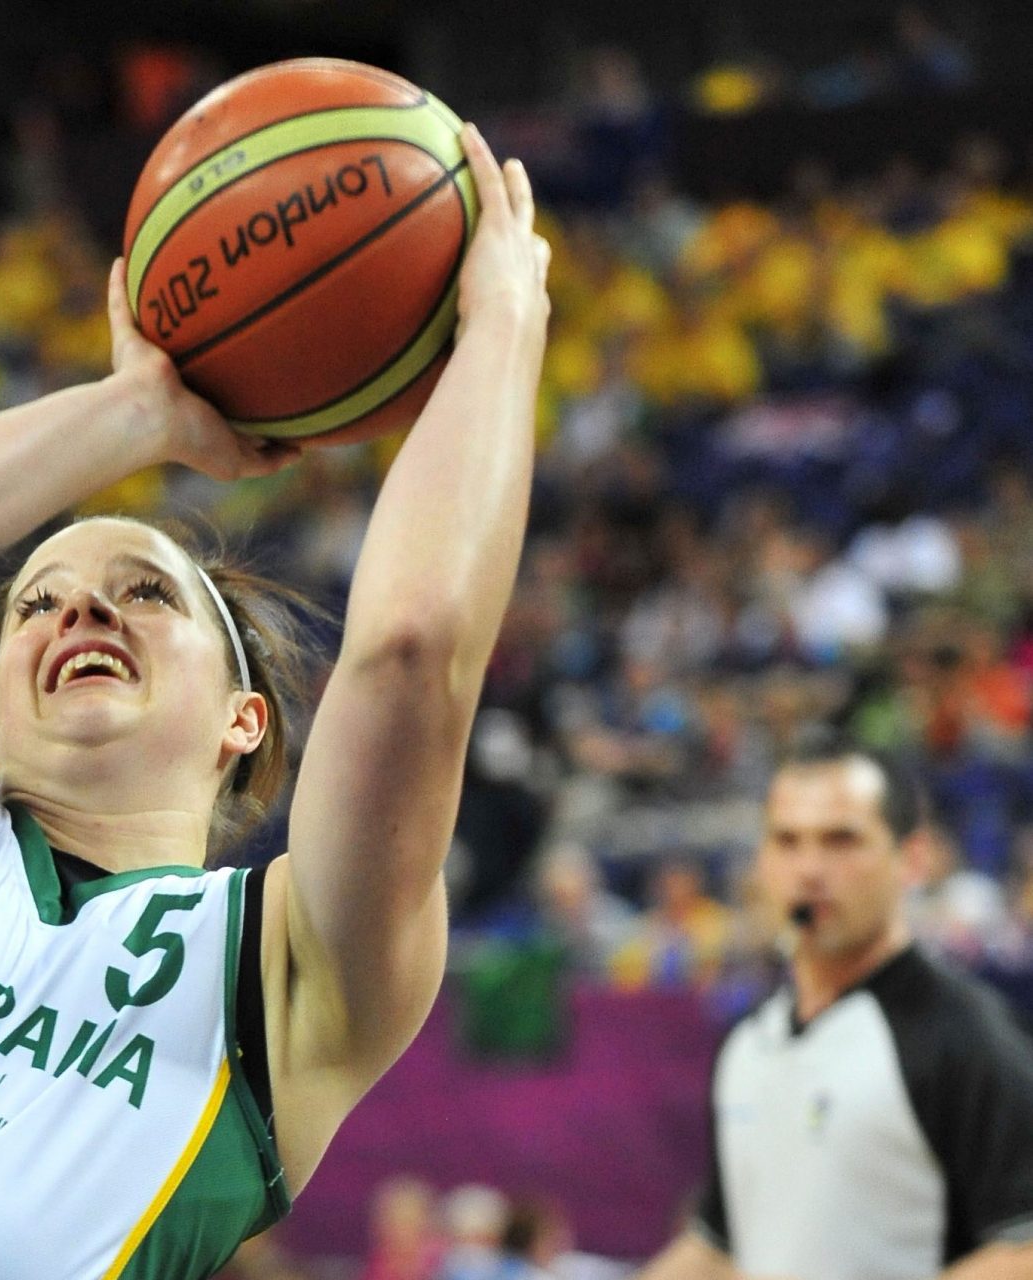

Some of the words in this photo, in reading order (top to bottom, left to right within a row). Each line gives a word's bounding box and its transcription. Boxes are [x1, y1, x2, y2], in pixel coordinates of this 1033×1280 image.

[218, 152, 394, 267] London
[148, 258, 219, 339] 2012
[104, 892, 204, 1013] 5
